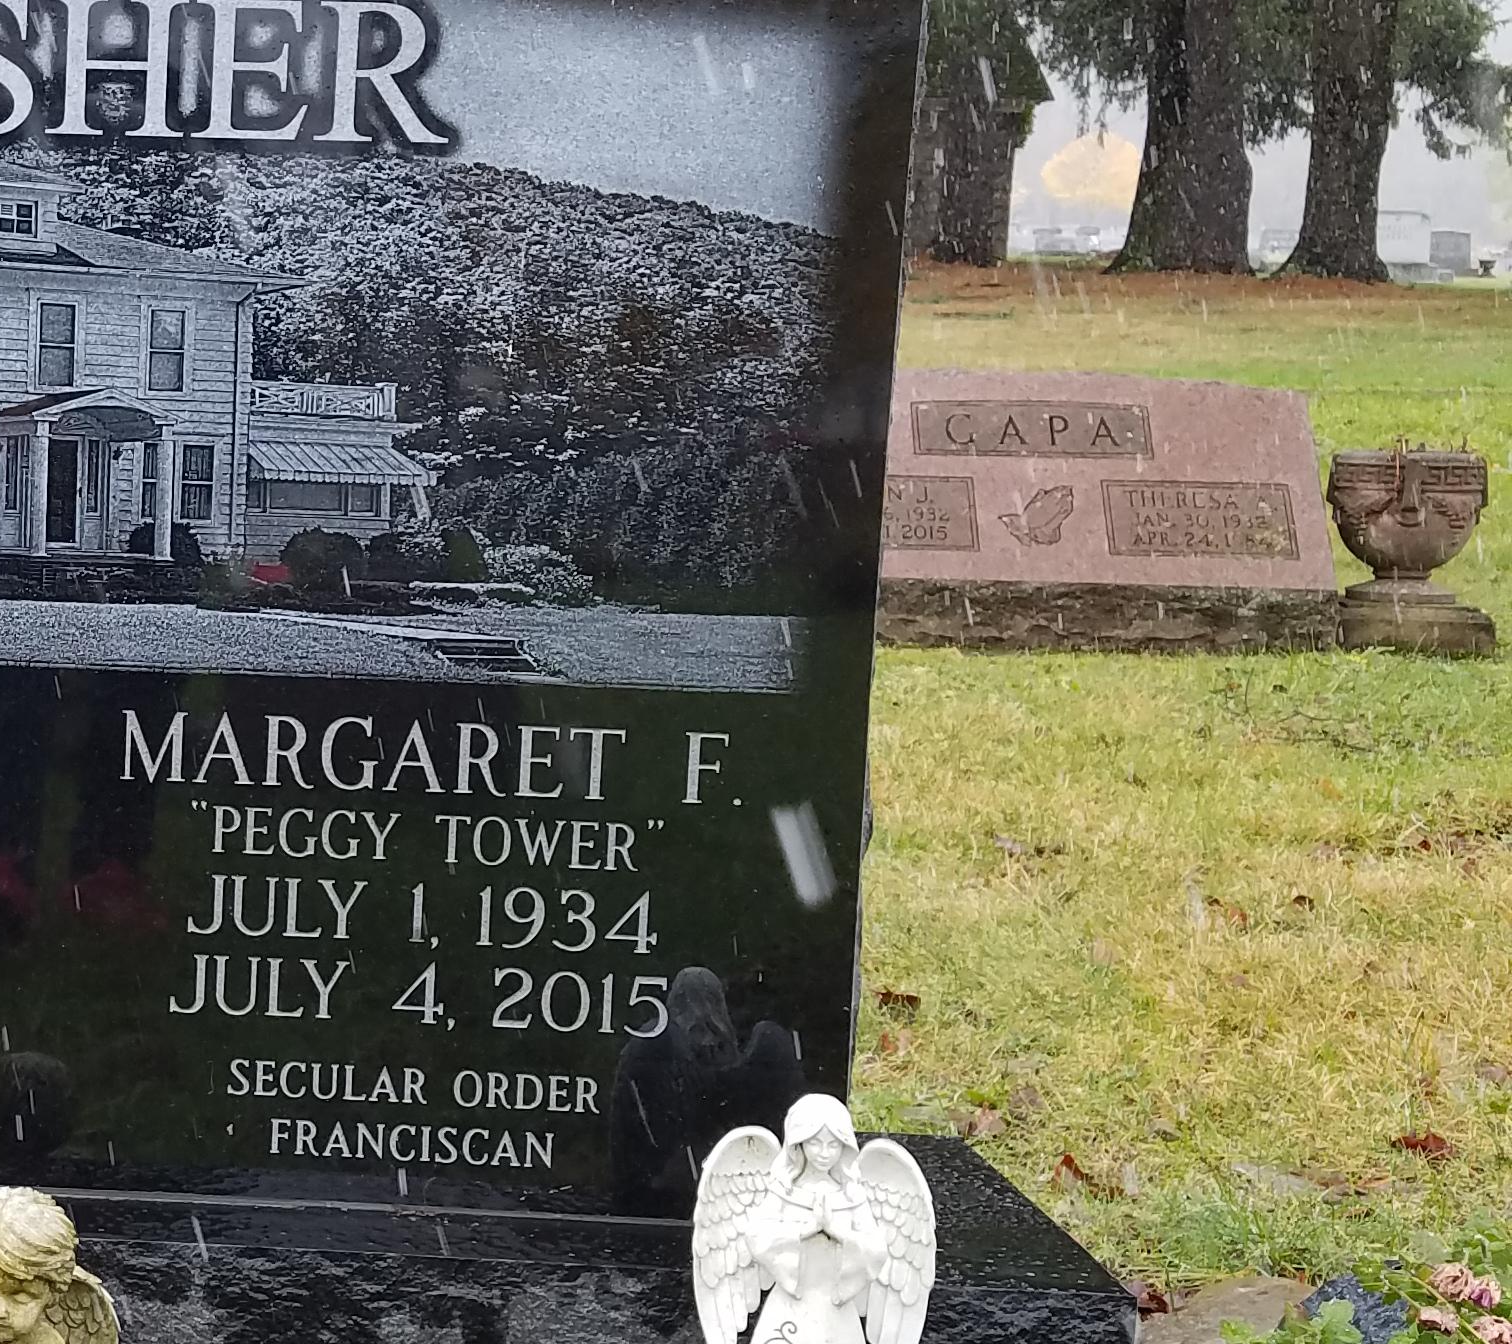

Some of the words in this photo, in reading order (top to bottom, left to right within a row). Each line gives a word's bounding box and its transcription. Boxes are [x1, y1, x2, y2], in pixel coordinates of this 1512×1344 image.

[945, 413, 1120, 447] CAPA
[901, 524, 948, 541] 2015
[120, 709, 627, 802] MARGARET
[681, 731, 744, 808] F.
[187, 873, 369, 940] JULY
[408, 882, 440, 950] 1,
[476, 886, 659, 956] 1934
[169, 953, 352, 1020] JULY
[392, 961, 457, 1033] 4,
[492, 968, 669, 1040] 2015
[227, 1058, 428, 1106] SECULAR
[454, 1069, 600, 1116] ORDER
[269, 1118, 555, 1169] FRANCISCAN
